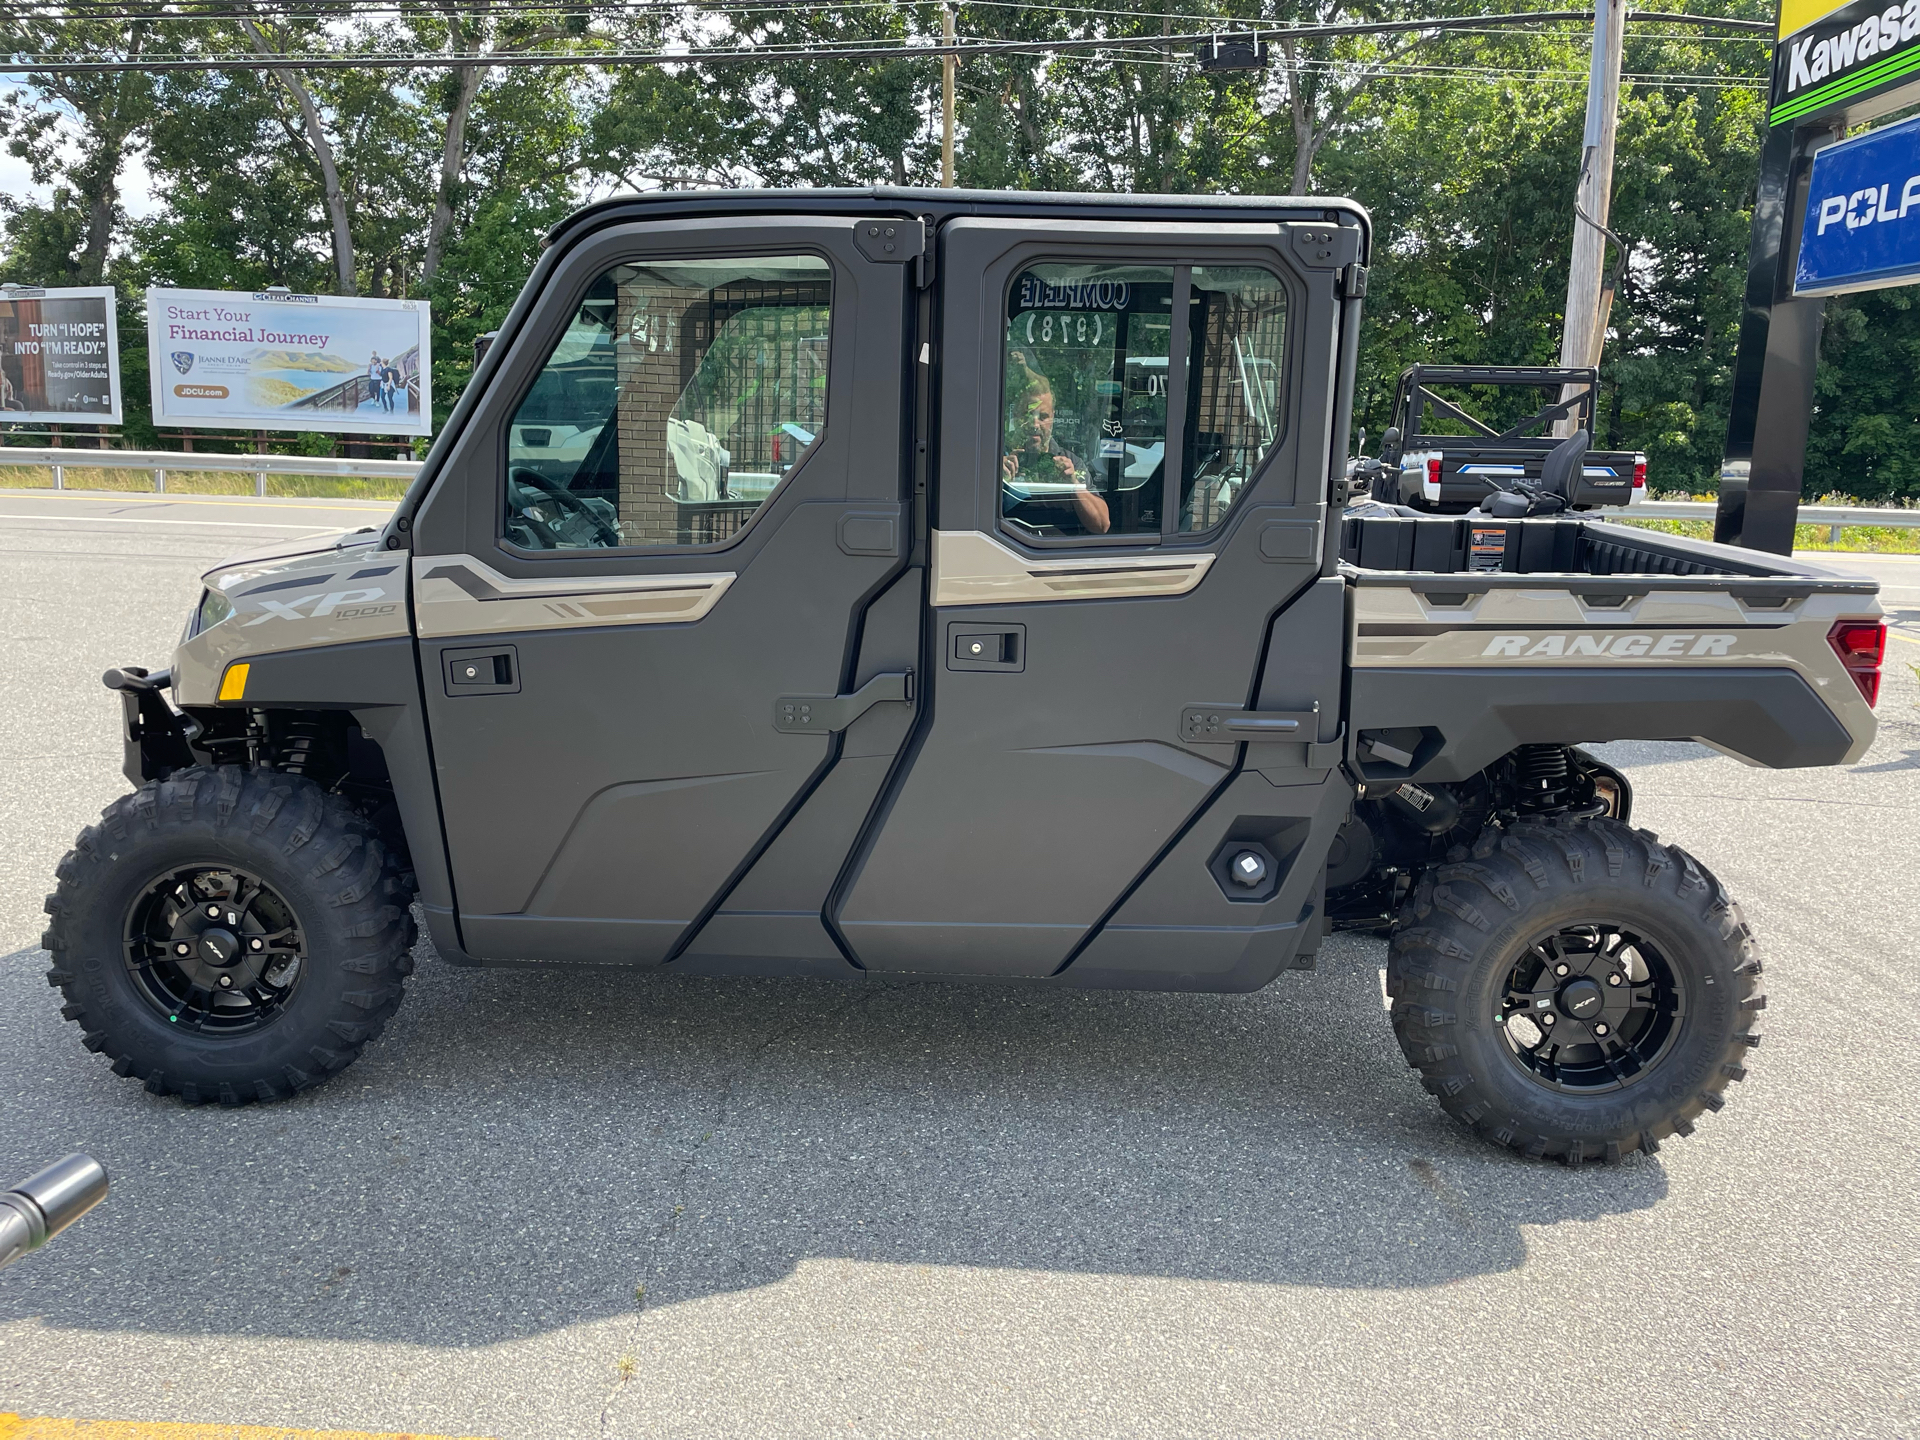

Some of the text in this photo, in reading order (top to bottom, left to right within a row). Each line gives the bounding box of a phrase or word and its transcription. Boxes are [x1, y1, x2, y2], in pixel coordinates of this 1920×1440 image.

[167, 306, 251, 322] Start Your
[28, 323, 58, 337] TURN
[168, 325, 330, 349] Financial Journey
[14, 341, 40, 355] INTO
[198, 355, 226, 364] JEANNE
[181, 389, 223, 397] JDCU.com
[241, 587, 387, 627] XP
[335, 604, 397, 619] 1000
[1481, 634, 1738, 657] RANGER
[1573, 996, 1596, 1010] XP
